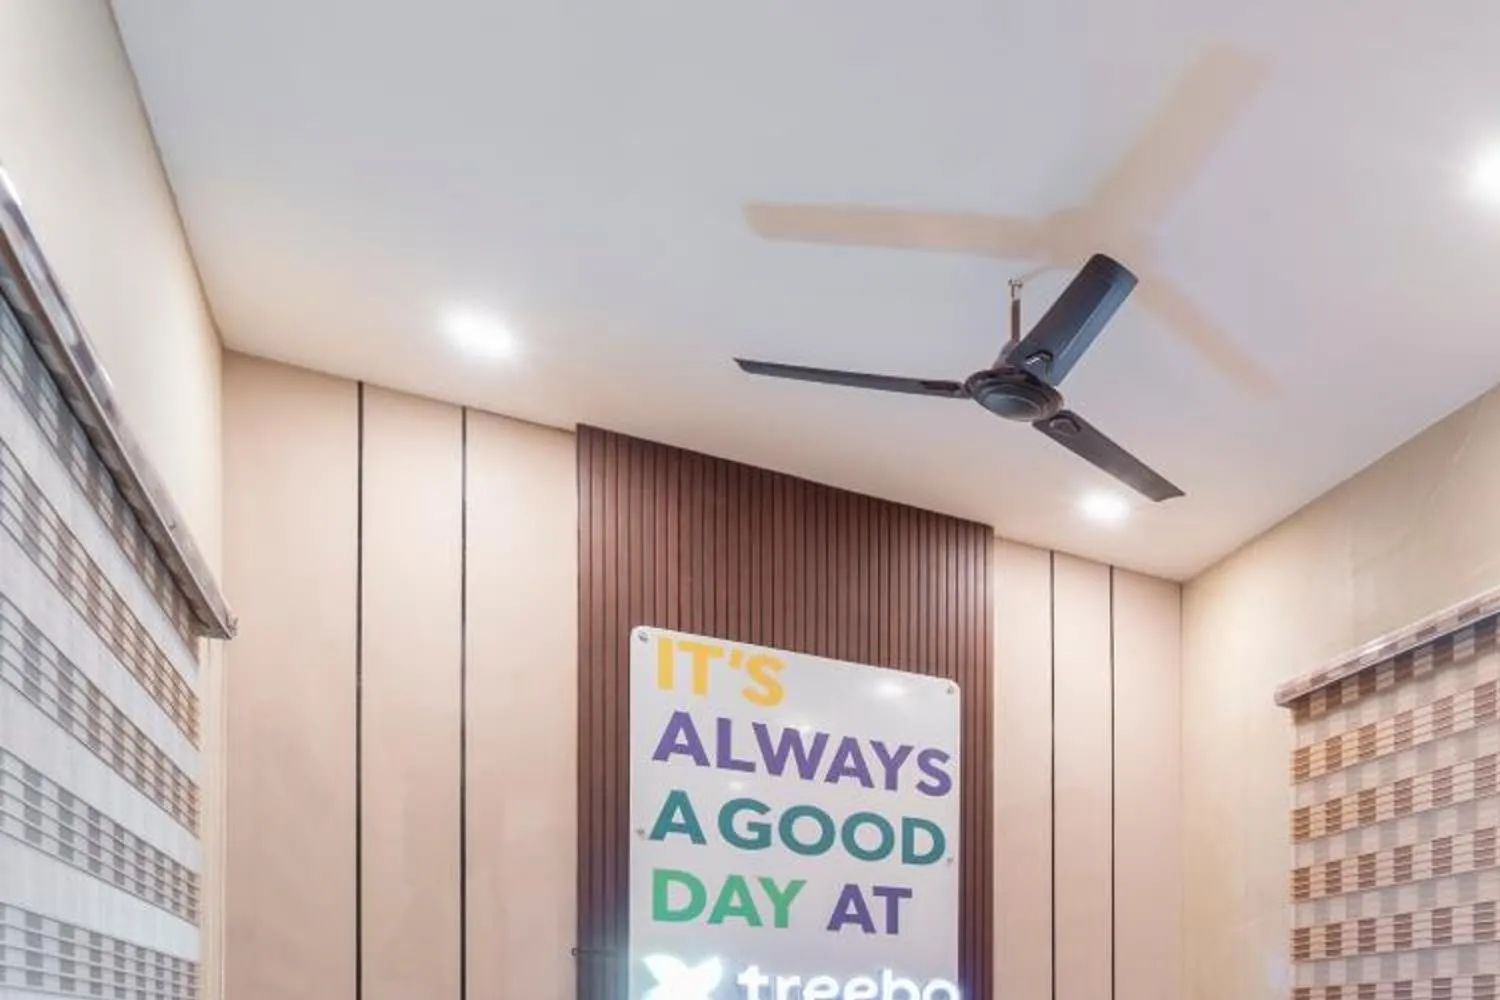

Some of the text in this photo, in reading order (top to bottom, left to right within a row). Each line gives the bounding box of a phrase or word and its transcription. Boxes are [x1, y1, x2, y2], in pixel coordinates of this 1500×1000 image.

[657, 636, 788, 707] IT'S
[652, 711, 952, 797] ALWAYS
[648, 790, 946, 865] A GOOD
[652, 869, 912, 934] DAY AT
